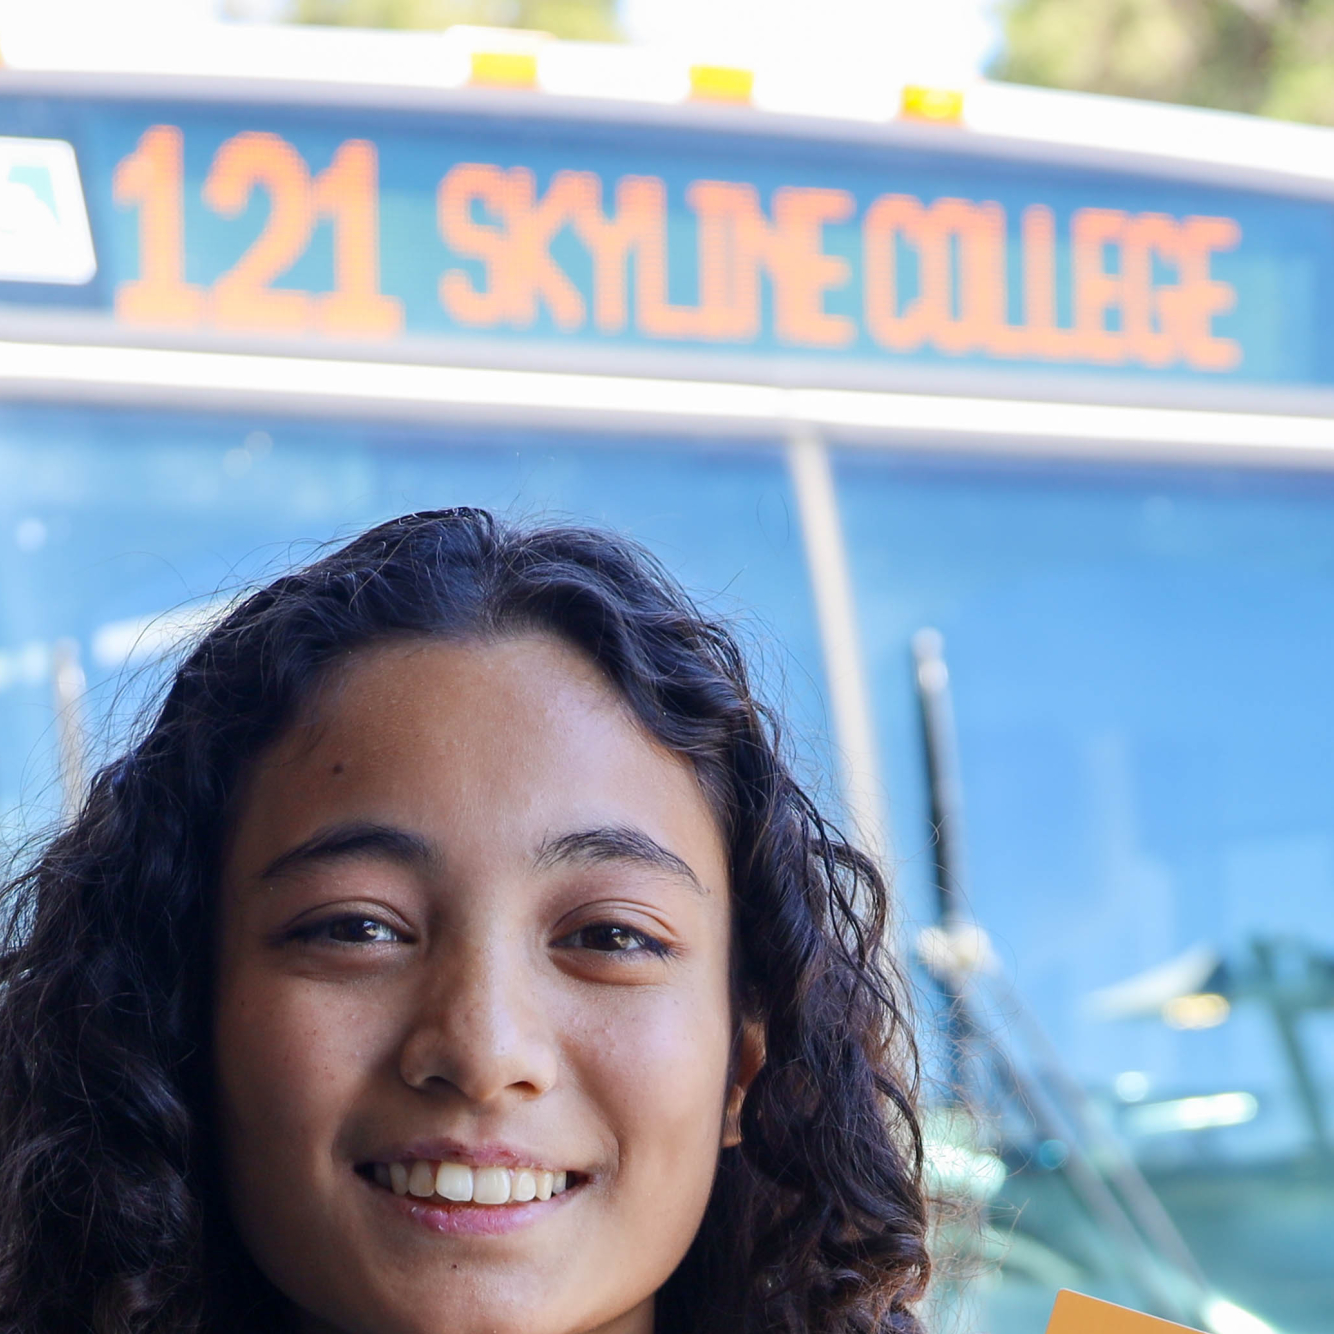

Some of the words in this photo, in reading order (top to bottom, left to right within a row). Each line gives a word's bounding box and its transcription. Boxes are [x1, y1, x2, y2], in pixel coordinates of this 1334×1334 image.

[114, 124, 405, 342] 121
[439, 162, 854, 346] SKYLINE
[863, 194, 1240, 369] COLLEGE
